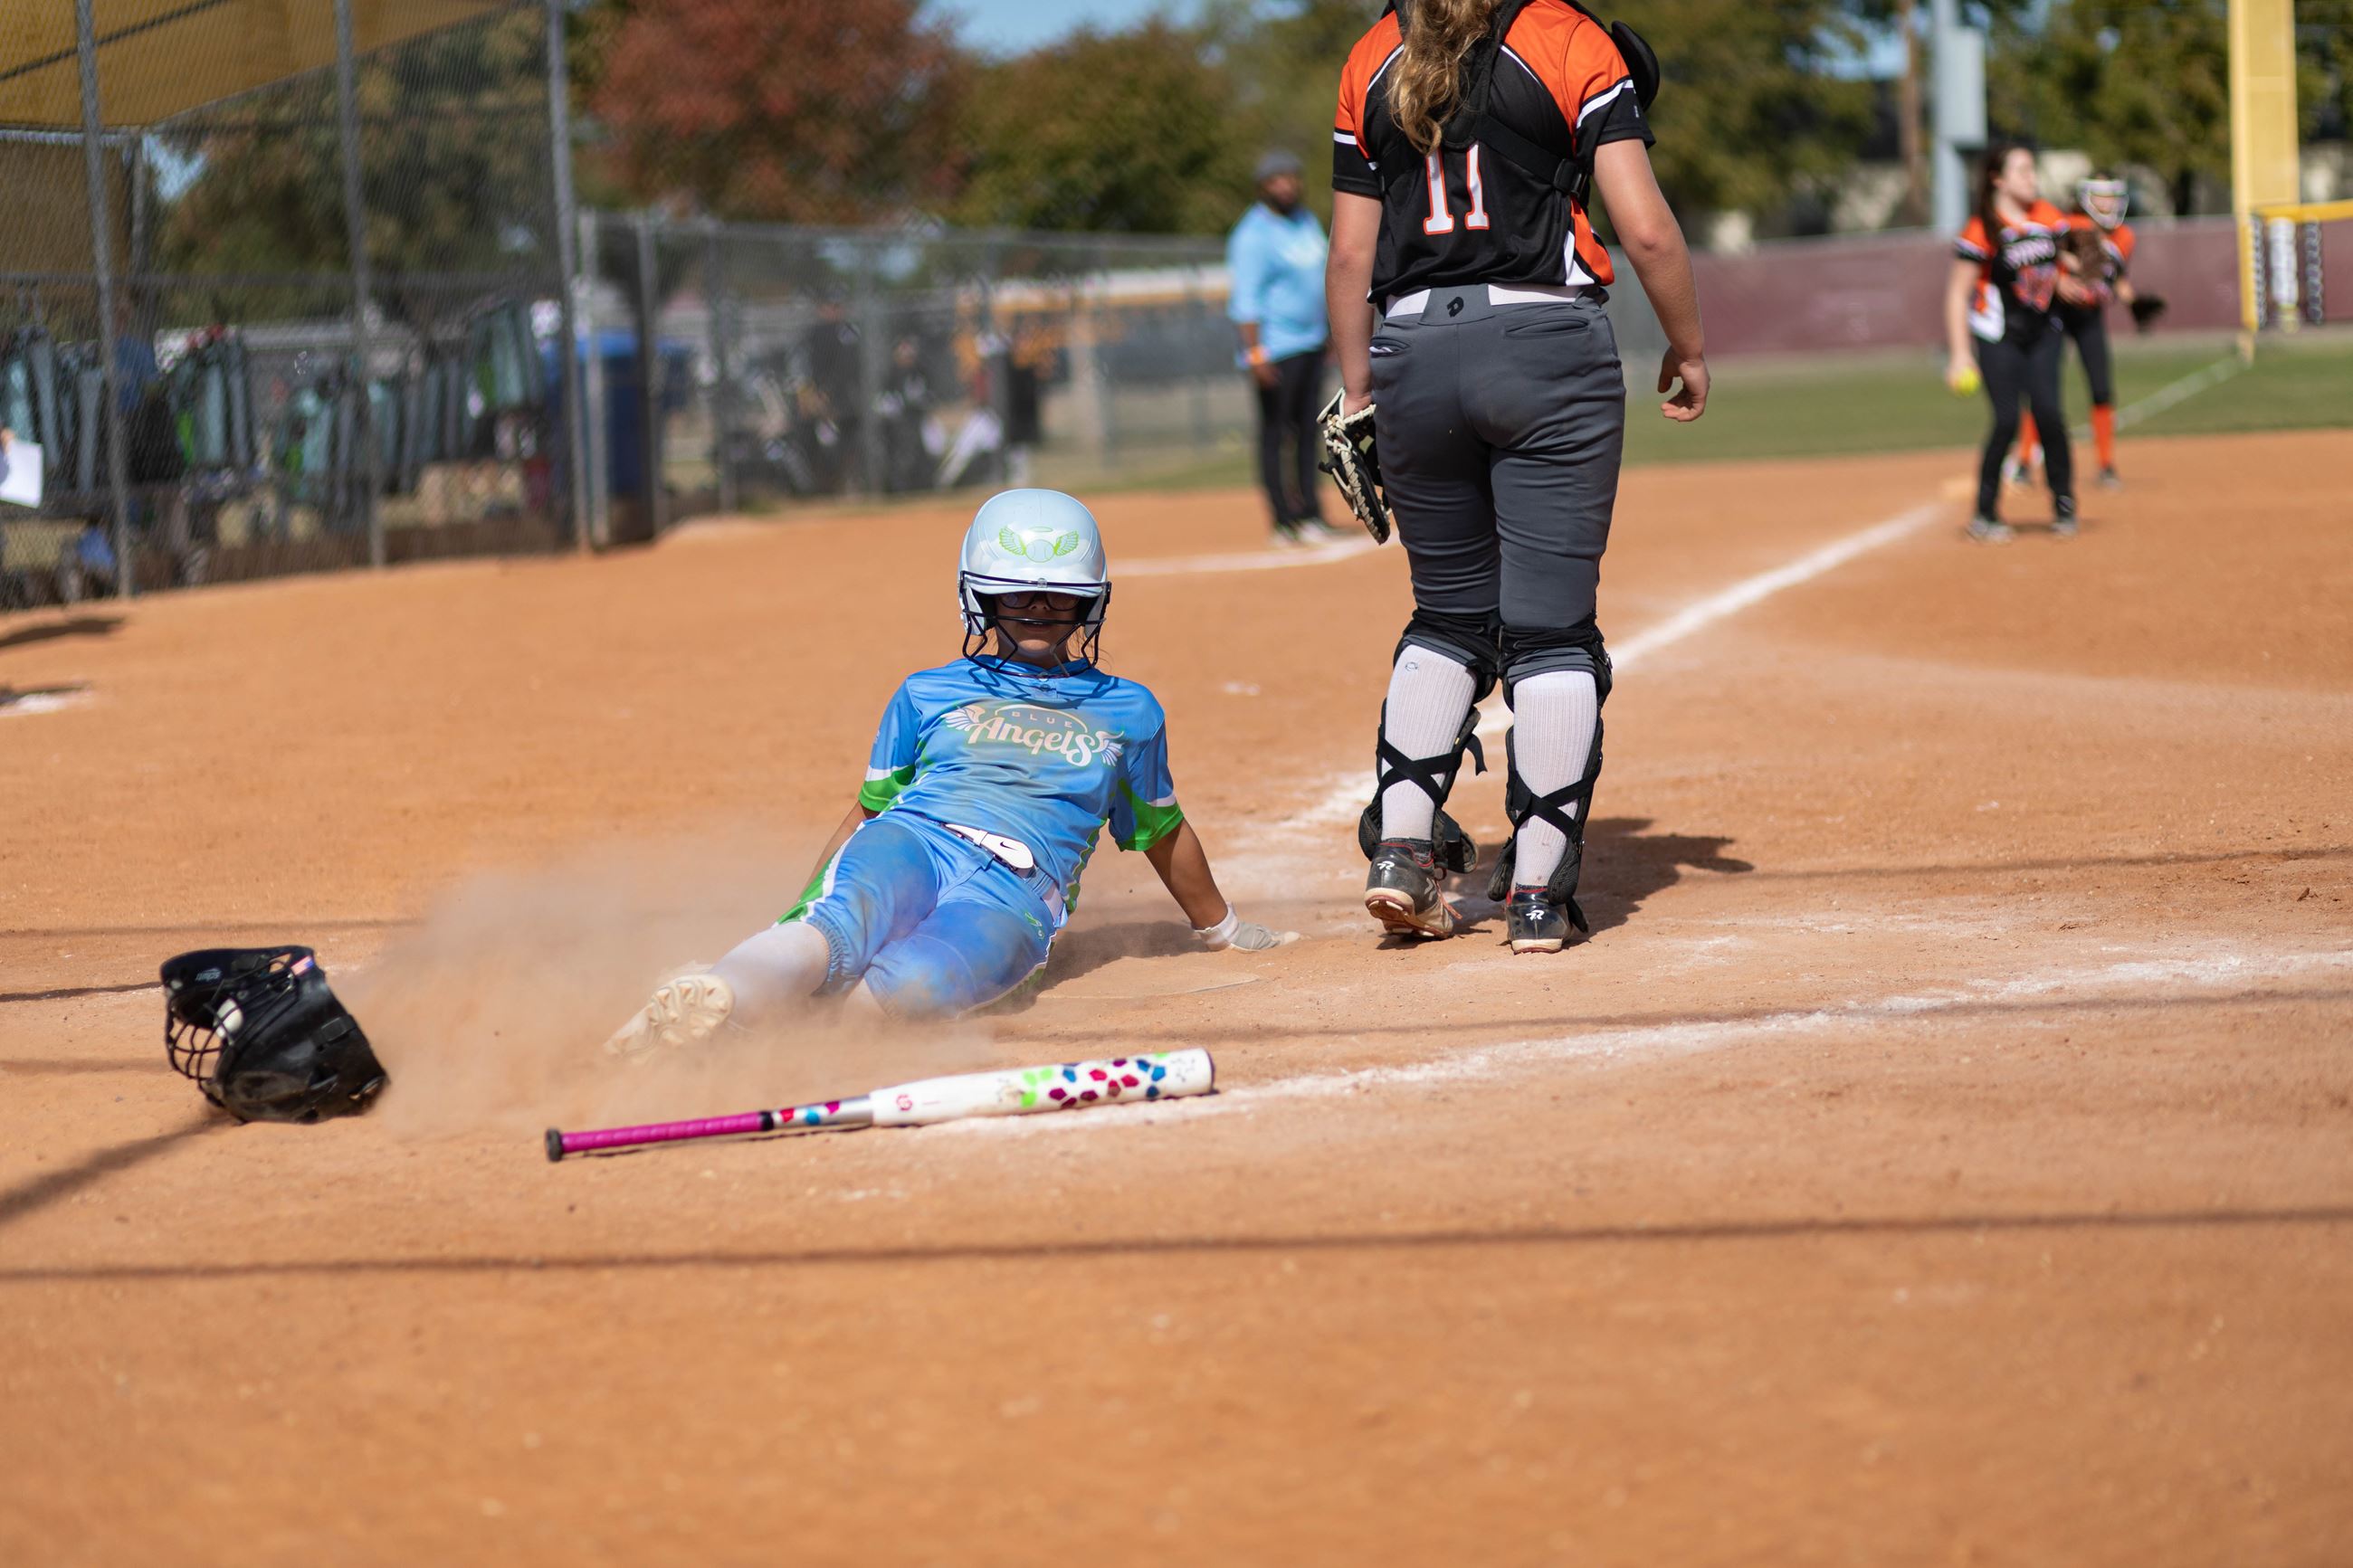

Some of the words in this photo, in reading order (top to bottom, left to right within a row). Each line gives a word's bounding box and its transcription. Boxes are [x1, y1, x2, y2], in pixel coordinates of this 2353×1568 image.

[1424, 143, 1490, 235] 11
[967, 717, 1095, 767] Angels
[1012, 711, 1072, 728] BLUE
